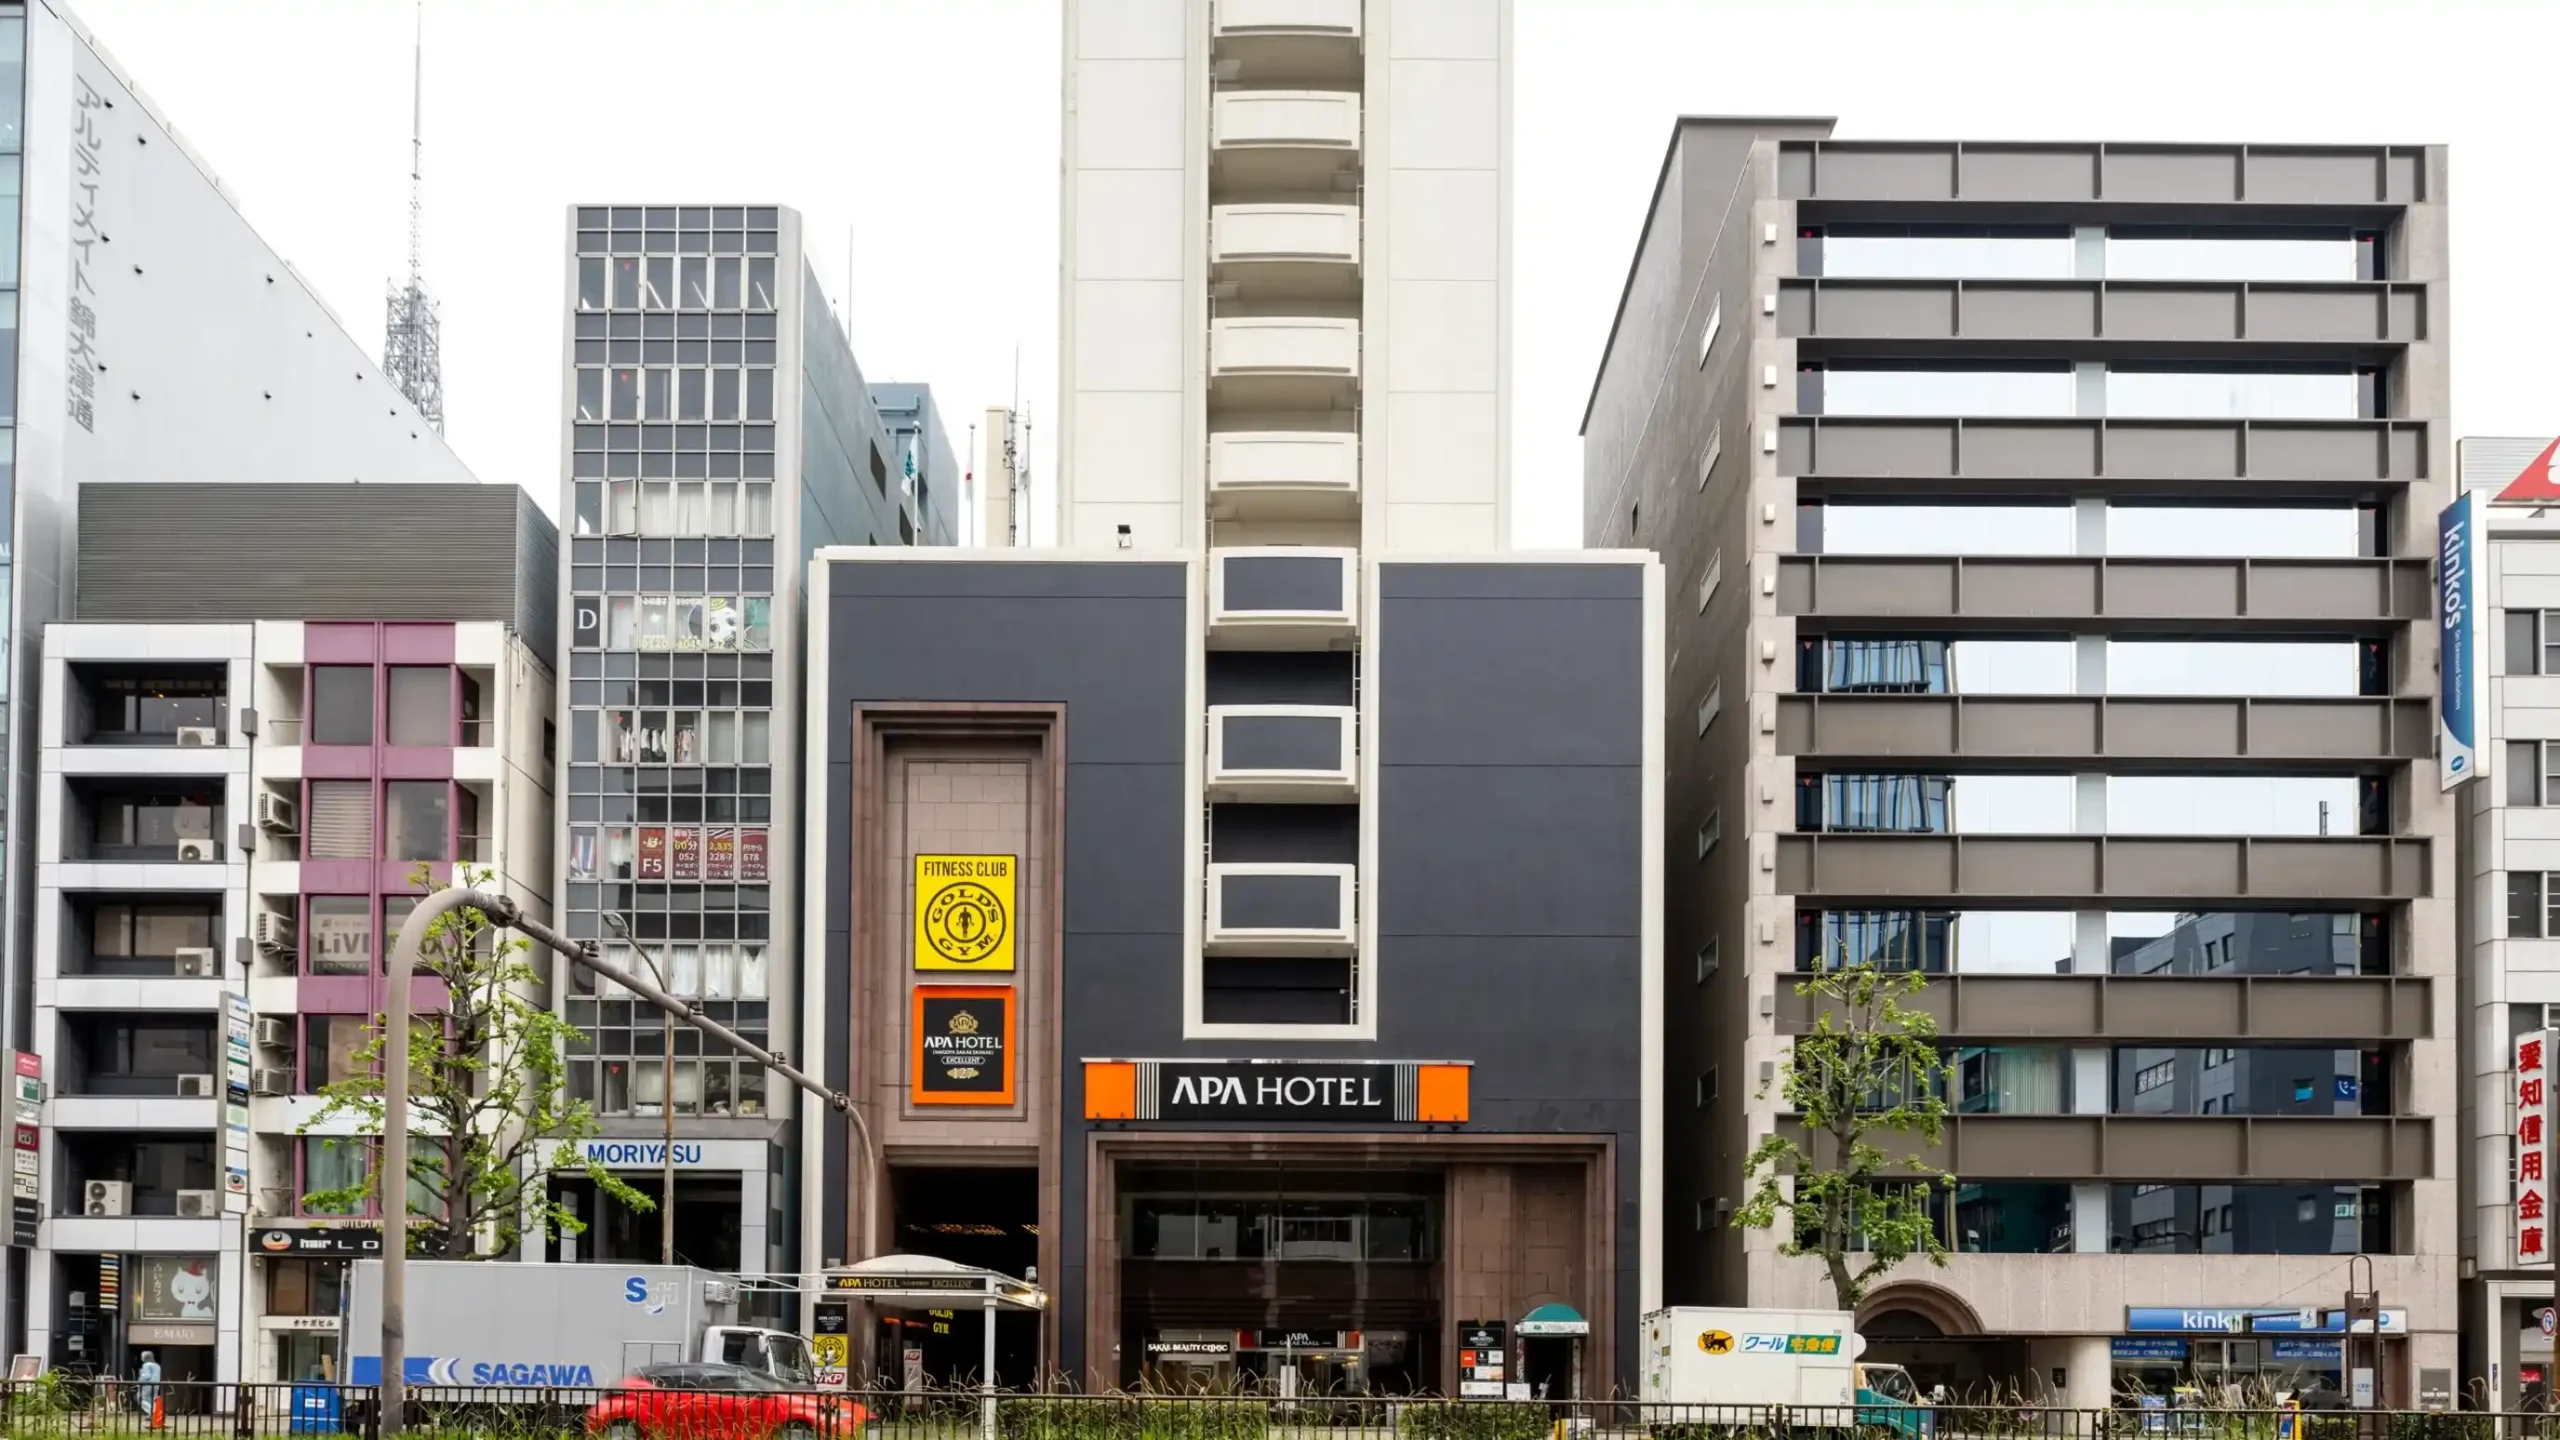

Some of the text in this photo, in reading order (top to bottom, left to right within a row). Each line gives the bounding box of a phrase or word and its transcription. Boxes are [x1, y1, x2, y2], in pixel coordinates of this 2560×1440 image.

[2444, 521, 2466, 629] kinko's
[578, 609, 597, 629] D
[643, 858, 662, 872] F5
[924, 861, 1007, 877] FITNESS CLUB
[932, 889, 999, 923] GOLD'S
[938, 934, 994, 956] GYM
[924, 1036, 1003, 1049] APA HOTEL
[945, 1056, 981, 1064] EXCELLENT
[953, 1067, 975, 1079] 127
[1172, 1077, 1382, 1106] APA HOTEL
[2518, 1040, 2543, 1256] 愛知信用金庫
[300, 1239, 331, 1249] hair
[839, 1278, 861, 1287] APA
[864, 1279, 900, 1288] HOTEL
[472, 1363, 594, 1386] SAGAWA
